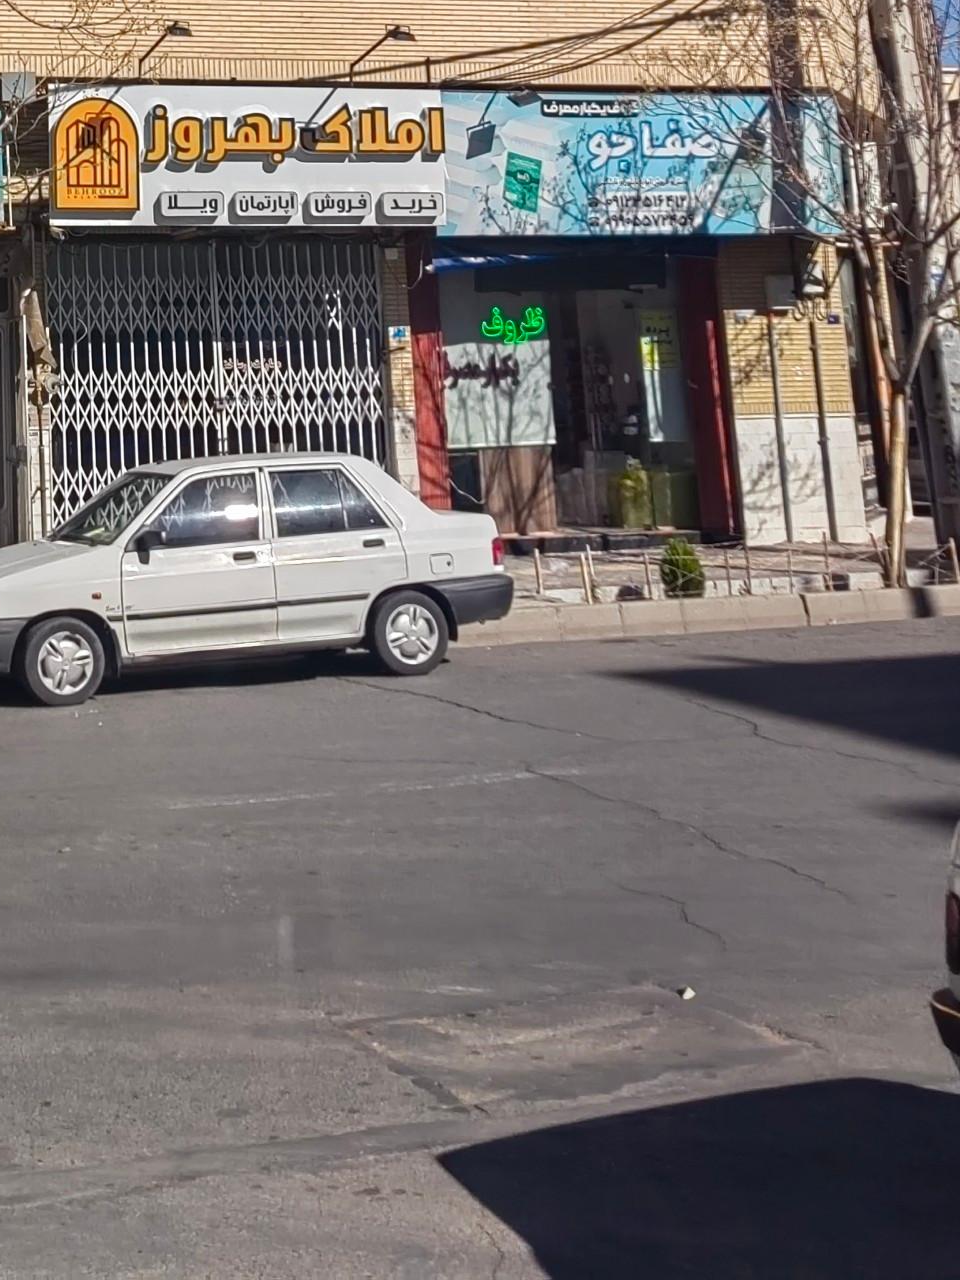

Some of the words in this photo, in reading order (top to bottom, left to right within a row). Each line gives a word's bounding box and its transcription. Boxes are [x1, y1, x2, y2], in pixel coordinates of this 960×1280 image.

[144, 104, 296, 164] بهروز
[298, 102, 445, 154] املاک
[66, 187, 124, 195] BEHROOZ
[166, 193, 218, 214] ویلا
[239, 193, 295, 215] آپارتمان
[314, 193, 368, 213] فروش
[390, 194, 438, 213] خرید
[481, 306, 545, 344] ظروف
